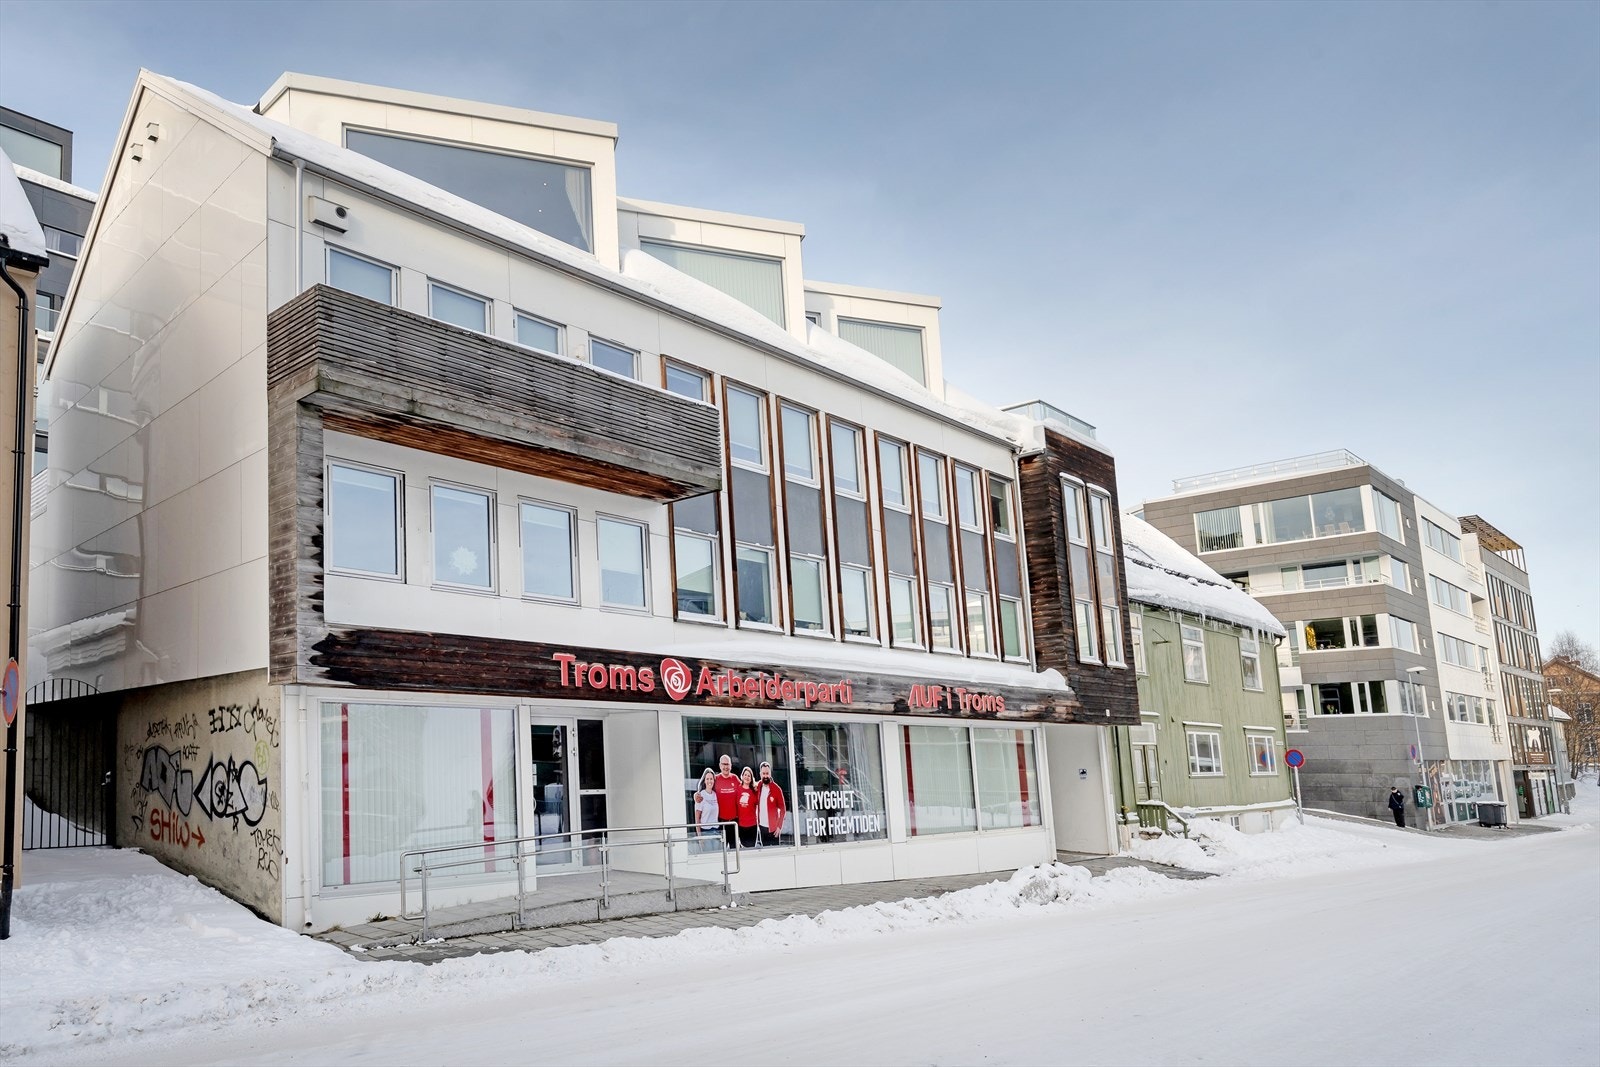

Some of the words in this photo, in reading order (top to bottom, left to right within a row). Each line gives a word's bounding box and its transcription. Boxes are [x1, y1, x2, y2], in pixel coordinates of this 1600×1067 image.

[552, 653, 655, 693] Troms
[696, 667, 853, 708] Arbeiderparti
[956, 687, 1006, 713] Troms
[804, 790, 855, 811] TRYGGHET
[806, 816, 827, 837] FOR
[828, 814, 881, 836] FREMTIDEN
